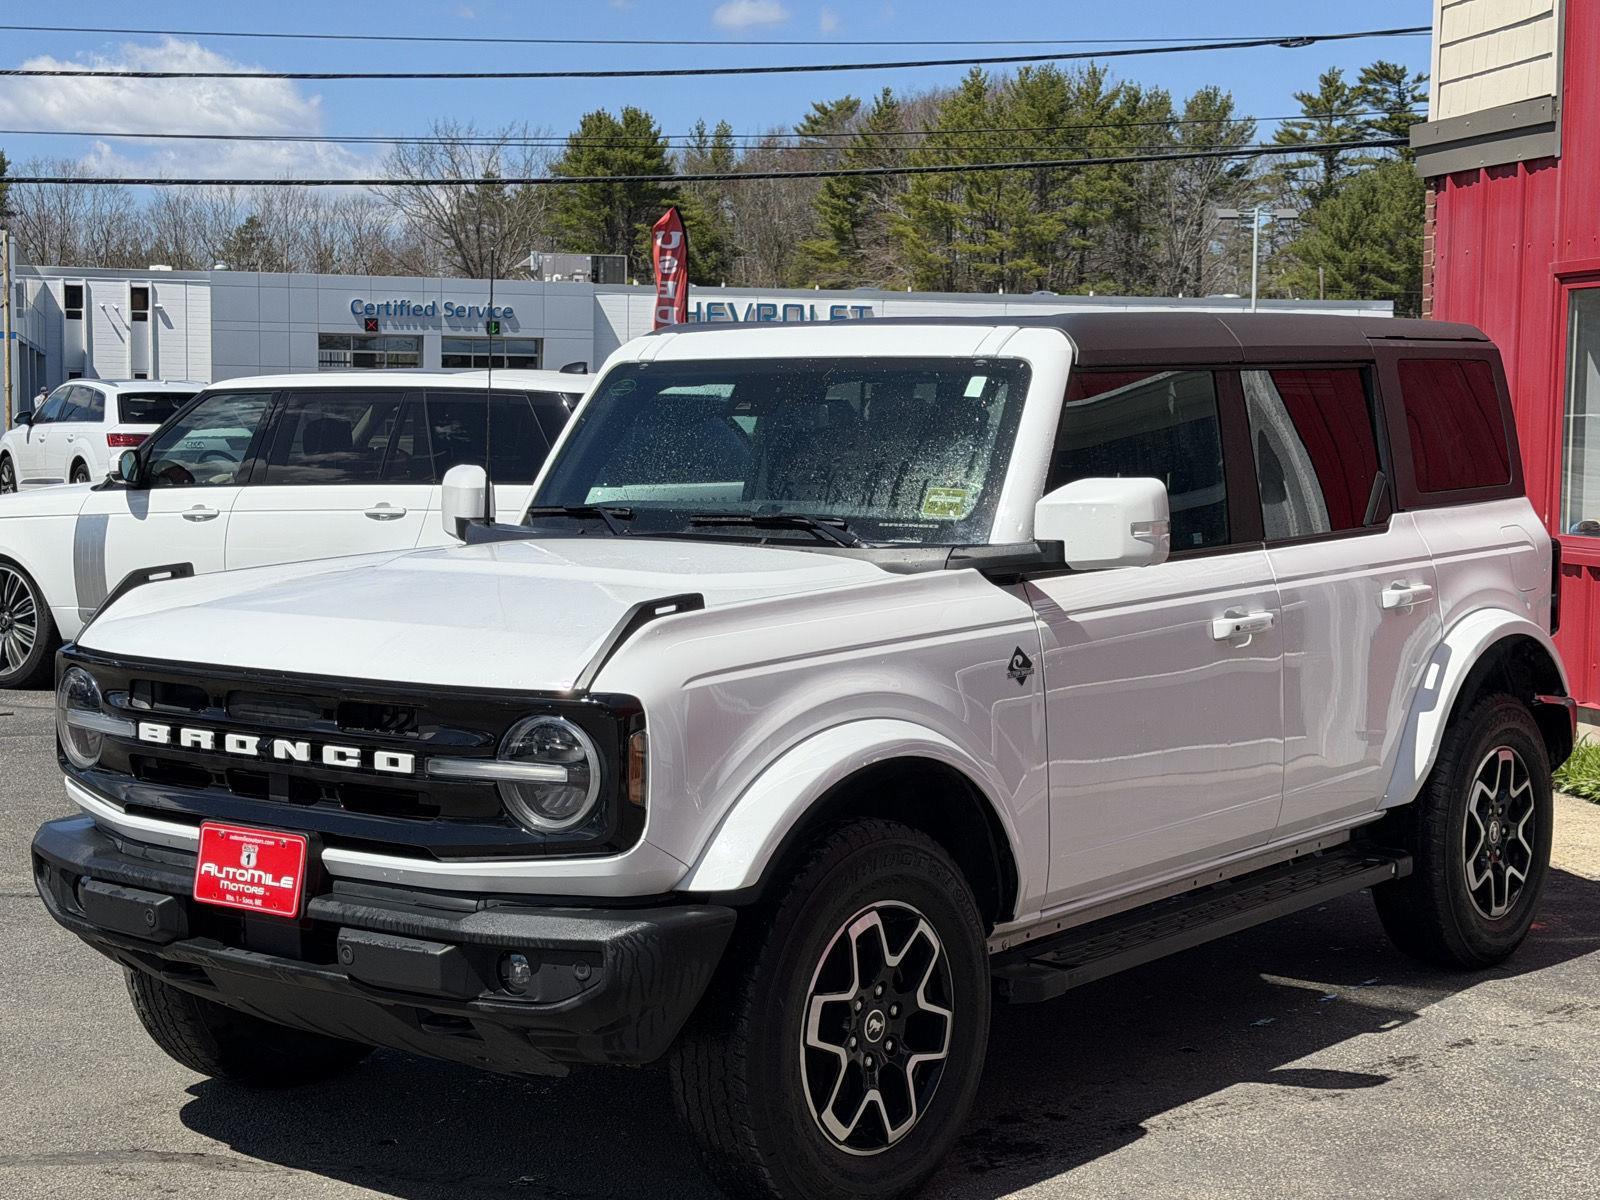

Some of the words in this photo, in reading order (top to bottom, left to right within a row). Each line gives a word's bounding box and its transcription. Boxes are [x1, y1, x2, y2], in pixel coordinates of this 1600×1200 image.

[350, 299, 436, 317] Certified
[443, 301, 514, 319] Service
[687, 301, 873, 322] HEVROLET
[138, 722, 416, 773] BRONCO
[246, 853, 251, 865] 1
[220, 880, 265, 896] MOTORS
